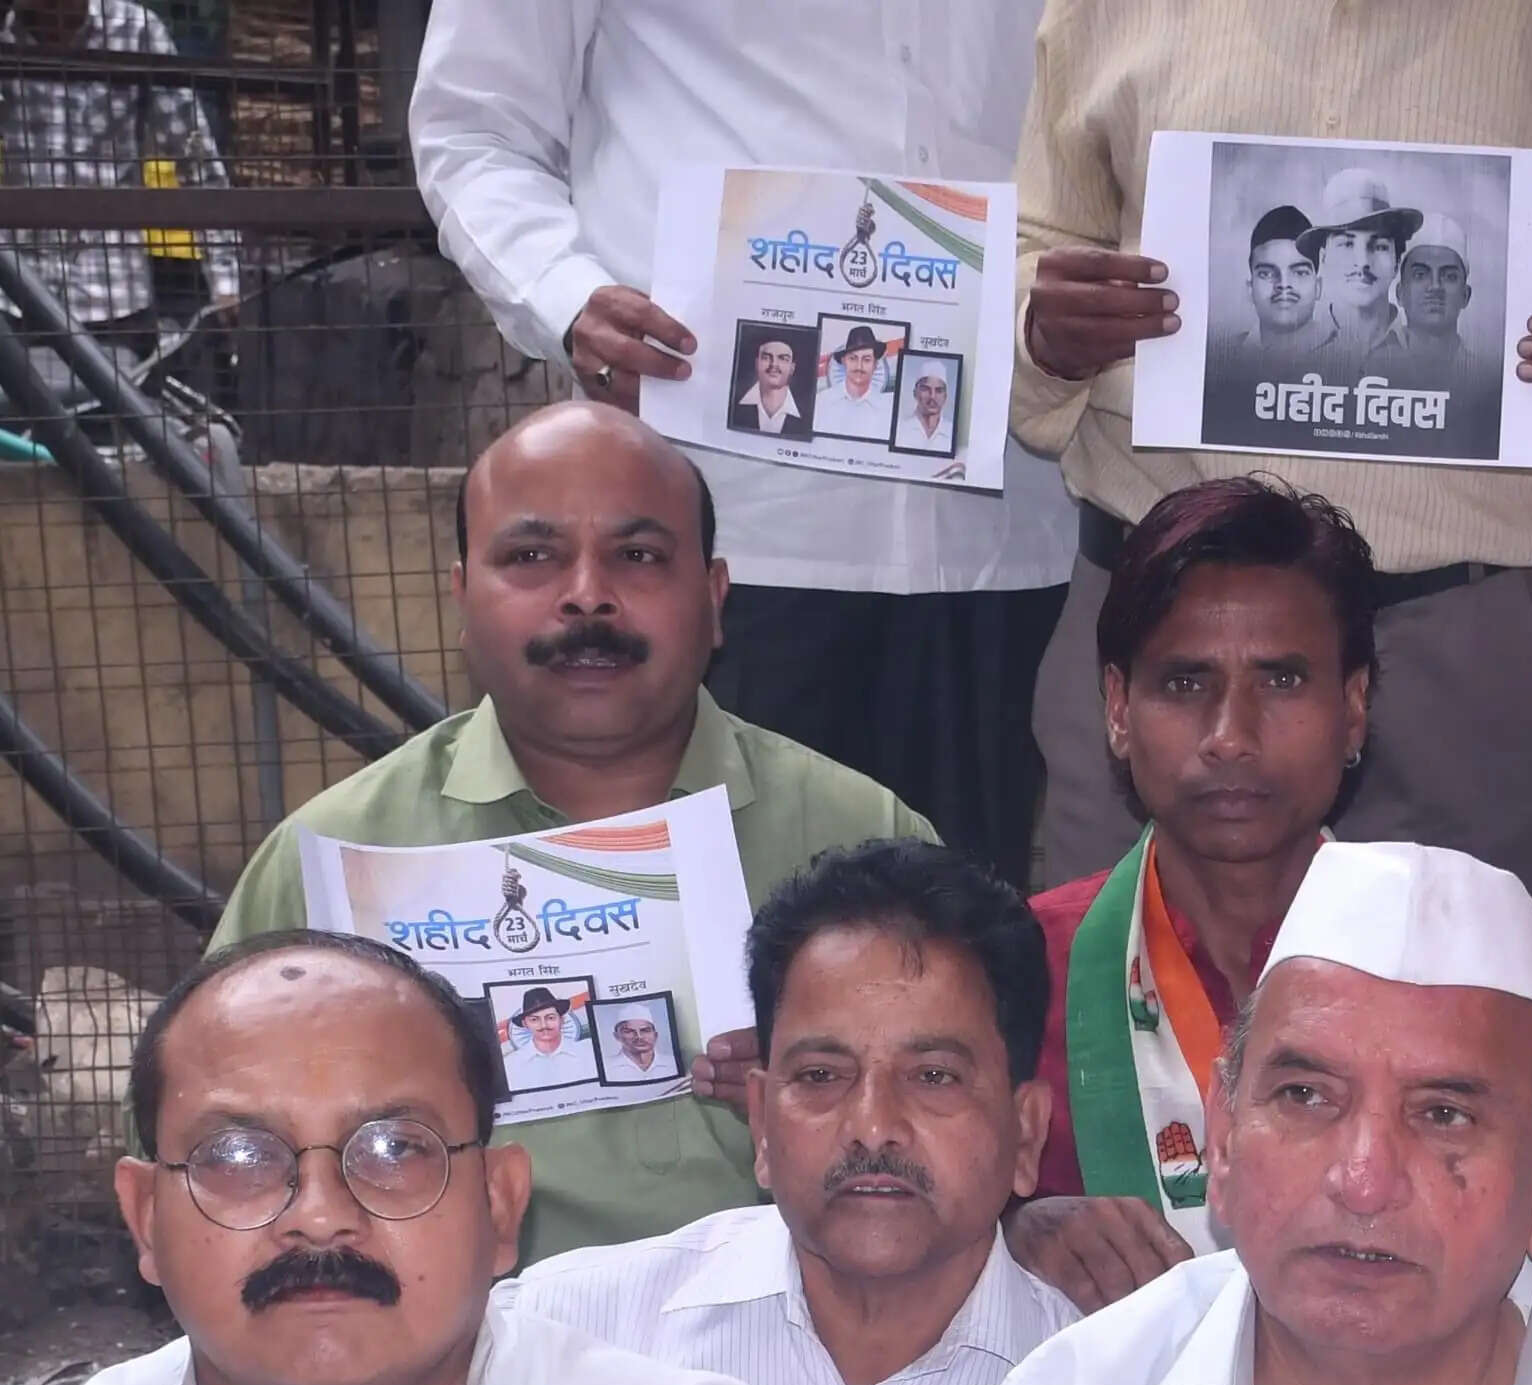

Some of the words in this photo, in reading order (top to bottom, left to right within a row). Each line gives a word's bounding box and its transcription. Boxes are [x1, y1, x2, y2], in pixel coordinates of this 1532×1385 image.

[748, 230, 838, 279] शहीद
[879, 241, 961, 289] दिवस
[850, 249, 867, 266] 23
[849, 266, 867, 280] मार्च
[1255, 373, 1348, 424] शहीद
[1354, 376, 1449, 429] दिवस
[384, 909, 492, 951] शहीद
[537, 897, 642, 942] दिवस
[505, 916, 525, 932] 23
[507, 932, 529, 944] मार्च
[507, 964, 534, 977] भगत
[538, 964, 560, 977] सिंह
[608, 980, 646, 995] सुखदेव
